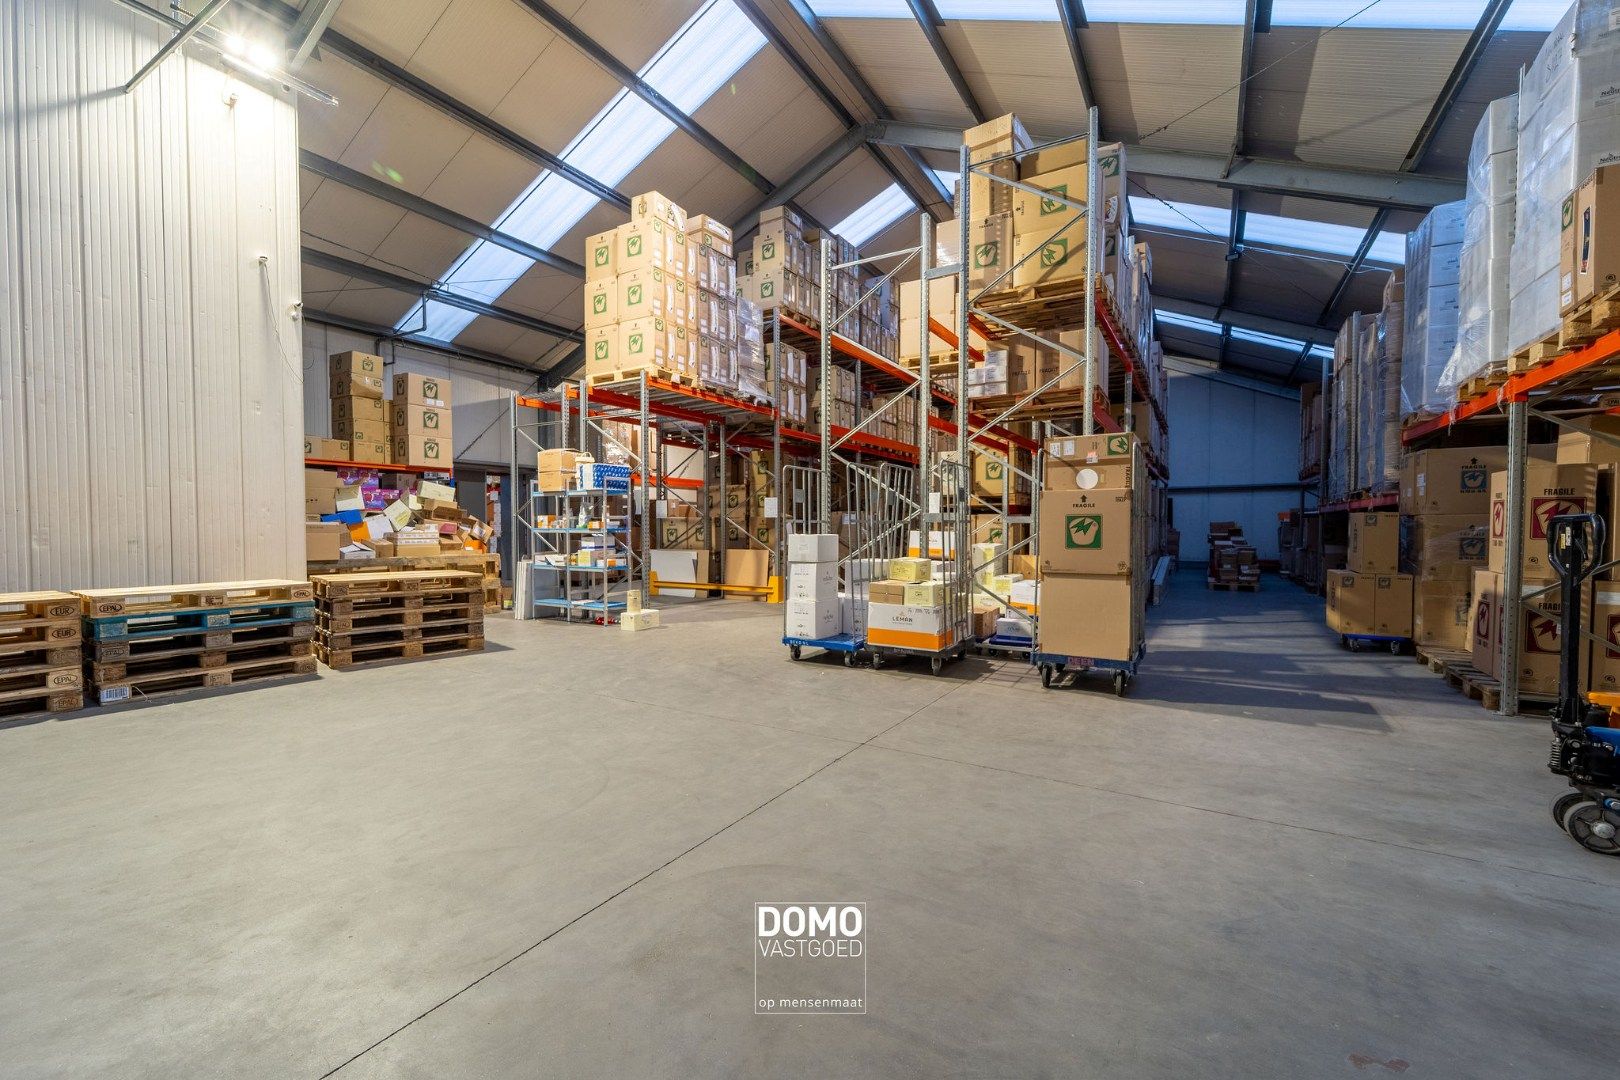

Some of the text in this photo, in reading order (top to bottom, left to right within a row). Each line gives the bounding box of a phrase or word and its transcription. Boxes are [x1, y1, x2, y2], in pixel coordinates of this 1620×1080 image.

[1543, 487, 1576, 496] FRAGILE
[55, 607, 71, 615] EUR
[1538, 602, 1561, 611] FRAGI
[56, 629, 71, 638] EUR
[1067, 656, 1095, 666] DEEN
